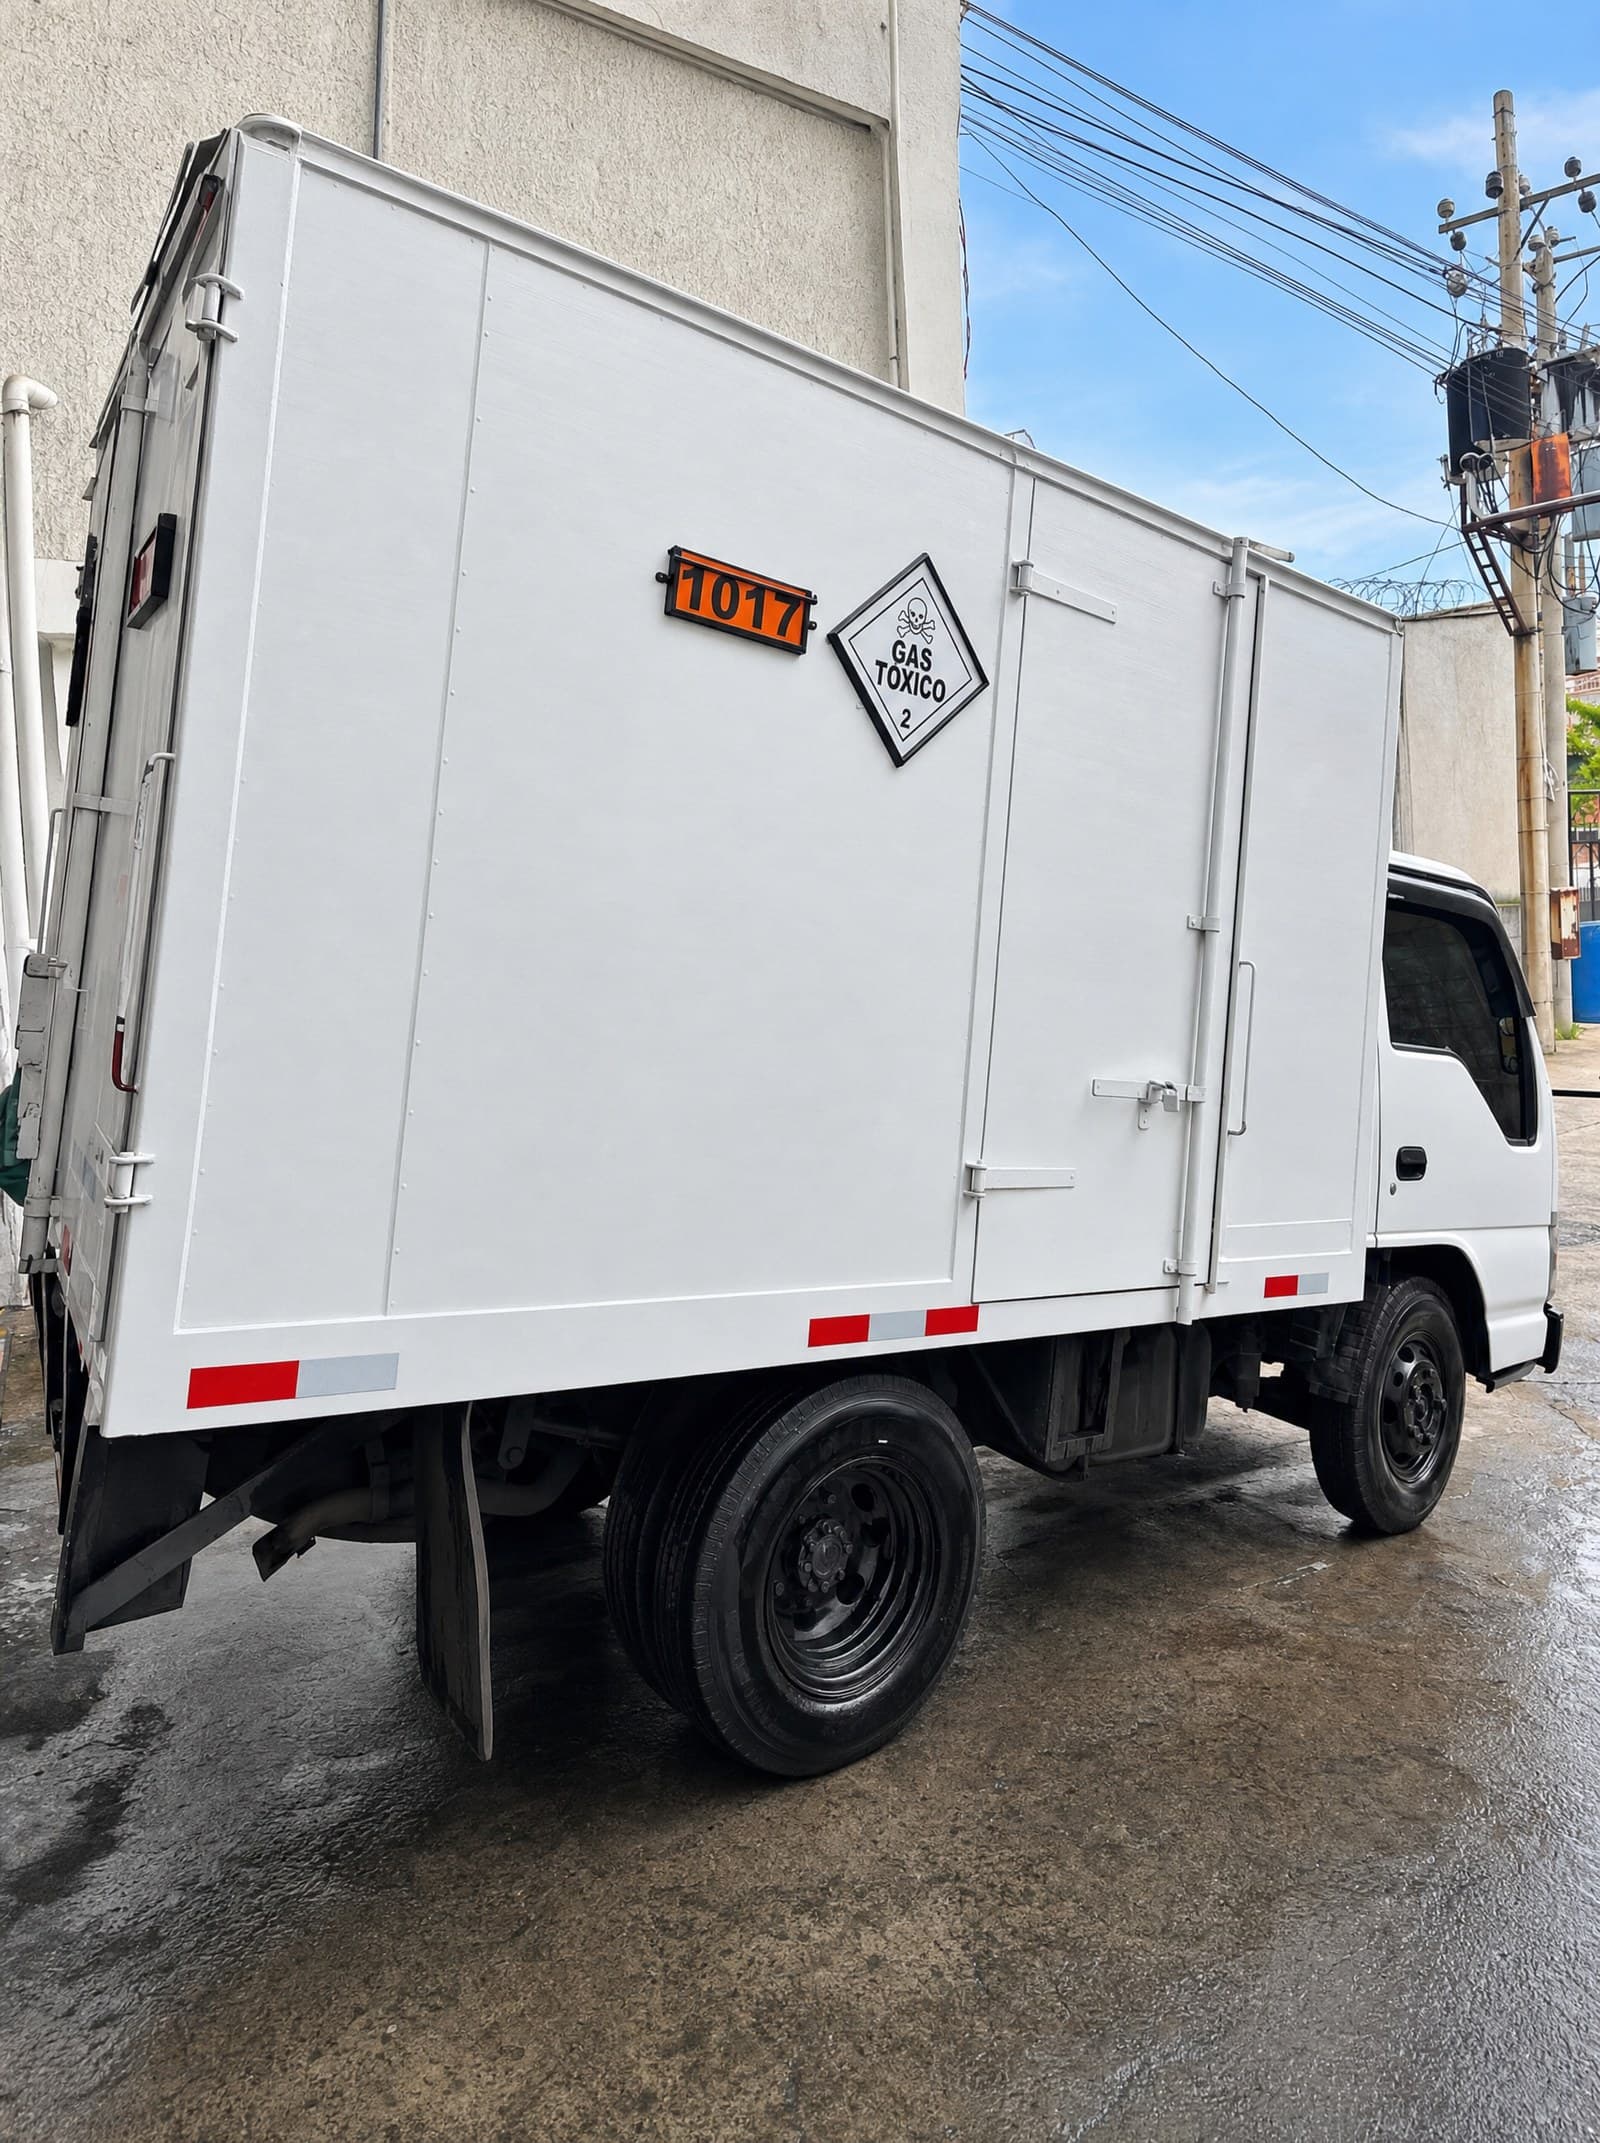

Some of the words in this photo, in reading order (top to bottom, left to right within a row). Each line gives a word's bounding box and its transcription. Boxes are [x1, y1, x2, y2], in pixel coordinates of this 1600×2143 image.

[682, 566, 801, 637] 1017
[892, 640, 932, 672] GAS
[900, 708, 911, 729] 2
